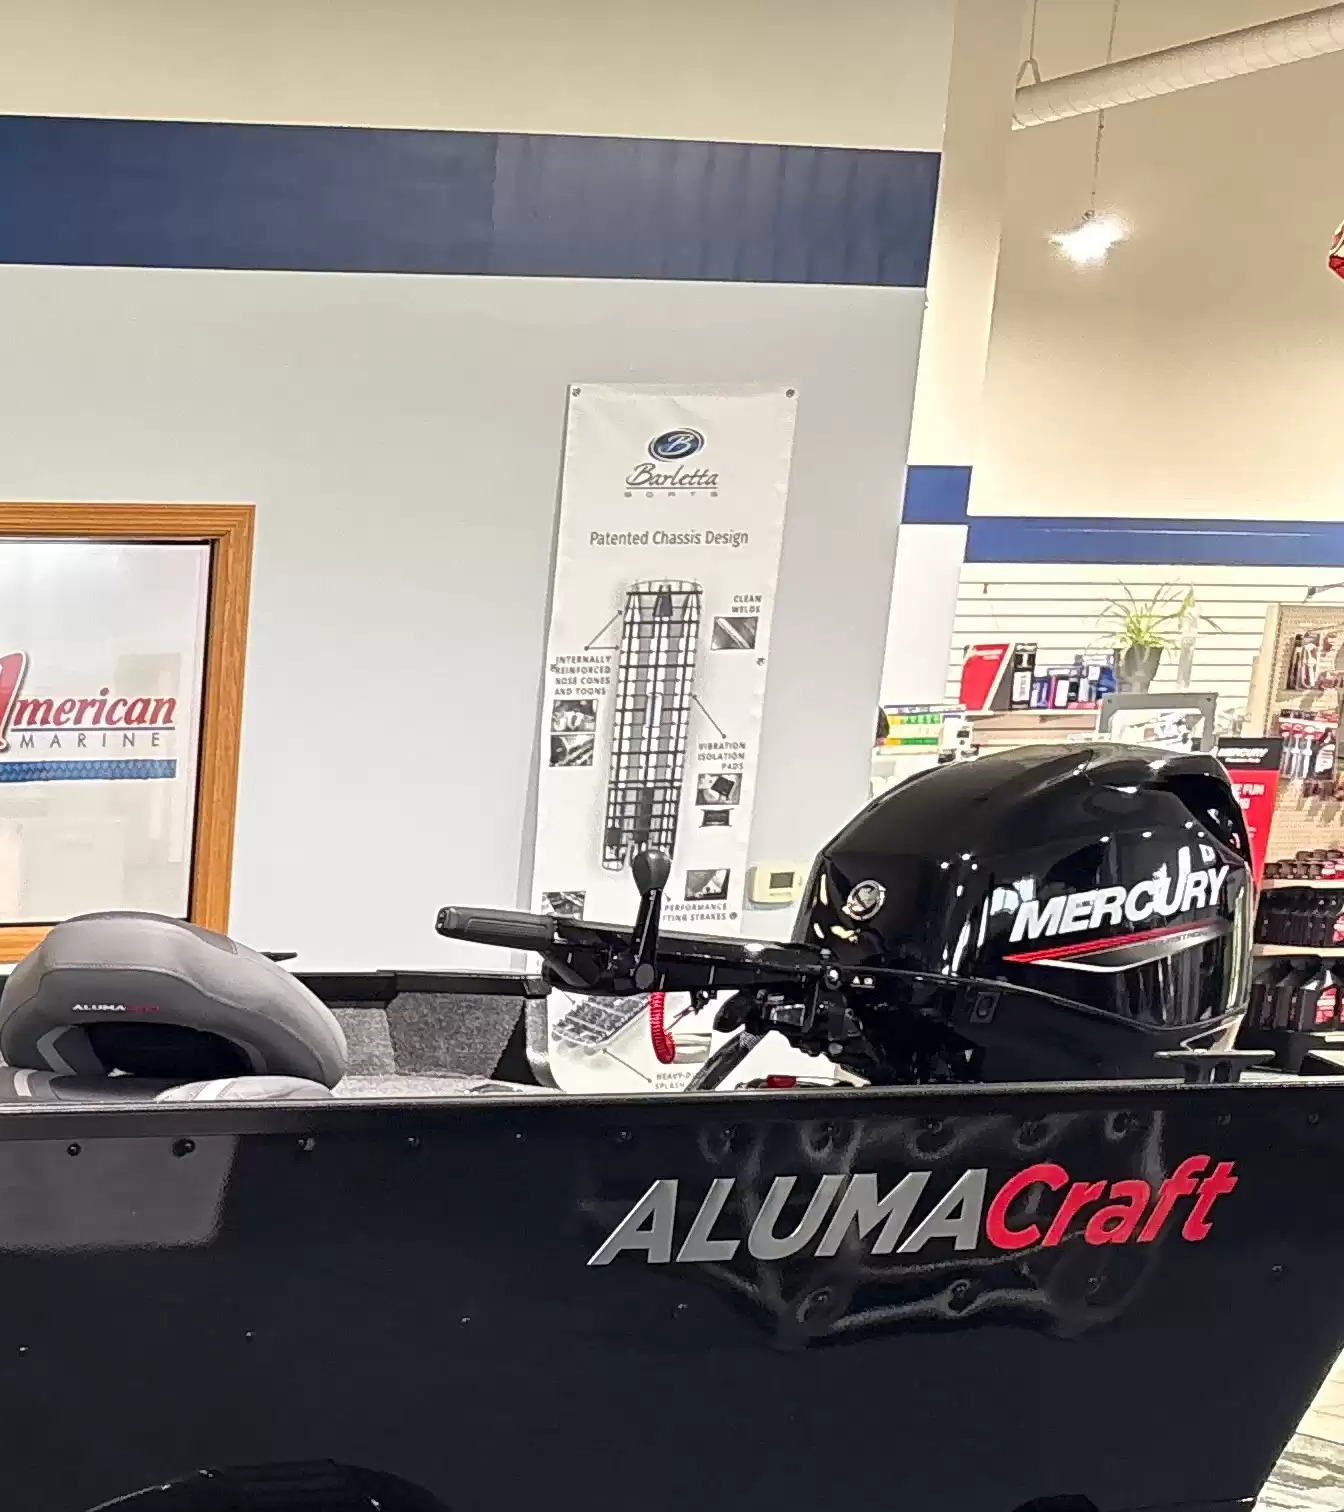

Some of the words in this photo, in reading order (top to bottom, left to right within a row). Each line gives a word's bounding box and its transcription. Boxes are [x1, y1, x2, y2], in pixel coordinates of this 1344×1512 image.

[625, 462, 720, 486] Barletta
[589, 531, 649, 546] Patented
[652, 530, 702, 545] Chassis
[705, 529, 749, 548] Design
[733, 594, 762, 603] CLEAN
[555, 655, 612, 664] INTERNALLY
[555, 666, 611, 674] REINFORCED
[555, 677, 577, 685] NOSE
[580, 676, 611, 685] CONES
[554, 687, 573, 696] AND
[575, 687, 607, 696] TOONS
[19, 731, 162, 749] MARINE
[698, 741, 746, 750] VIBRATION
[697, 752, 745, 761] ISOLATION
[721, 762, 744, 771] PADS
[1009, 858, 1230, 944] MERCURY
[664, 902, 728, 912] PERFORMANCE
[690, 913, 727, 922] STRAKES
[587, 1154, 1239, 1266] ALUMACraft
